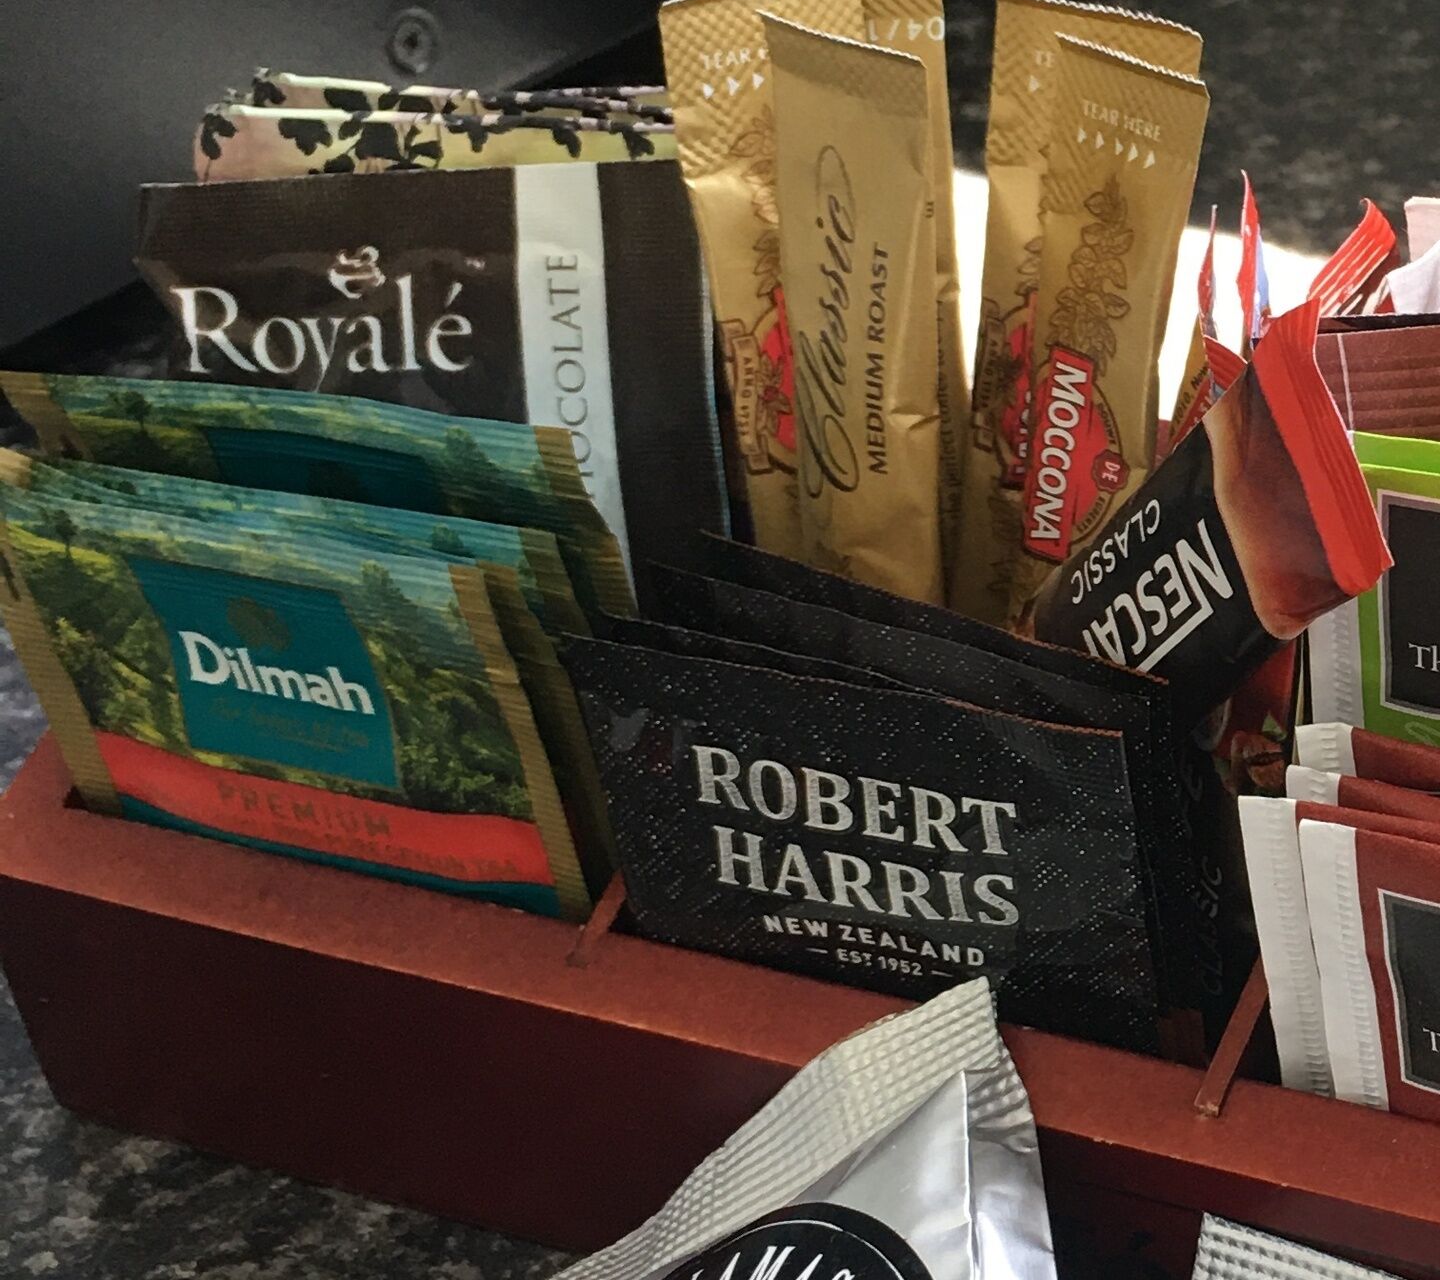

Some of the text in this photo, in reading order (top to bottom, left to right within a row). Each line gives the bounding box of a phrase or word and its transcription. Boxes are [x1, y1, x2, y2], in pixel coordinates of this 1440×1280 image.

[702, 47, 752, 70] TEAR
[868, 16, 945, 41] 04/1
[1035, 50, 1055, 68] TE
[1083, 99, 1161, 142] TEAR HERE
[170, 274, 472, 393] Royalé
[864, 242, 889, 475] MEDIUM ROAST
[1030, 361, 1088, 540] MOCCONA
[1070, 499, 1160, 605] CLASSIC
[1082, 518, 1234, 670] NESCA
[178, 630, 376, 715] Dilmah
[215, 780, 390, 836] PREMIUM
[692, 745, 1016, 856] ROBERT
[712, 825, 1020, 926] HARRIS
[763, 915, 985, 967] NEW ZEALAND
[878, 956, 923, 976] 1952
